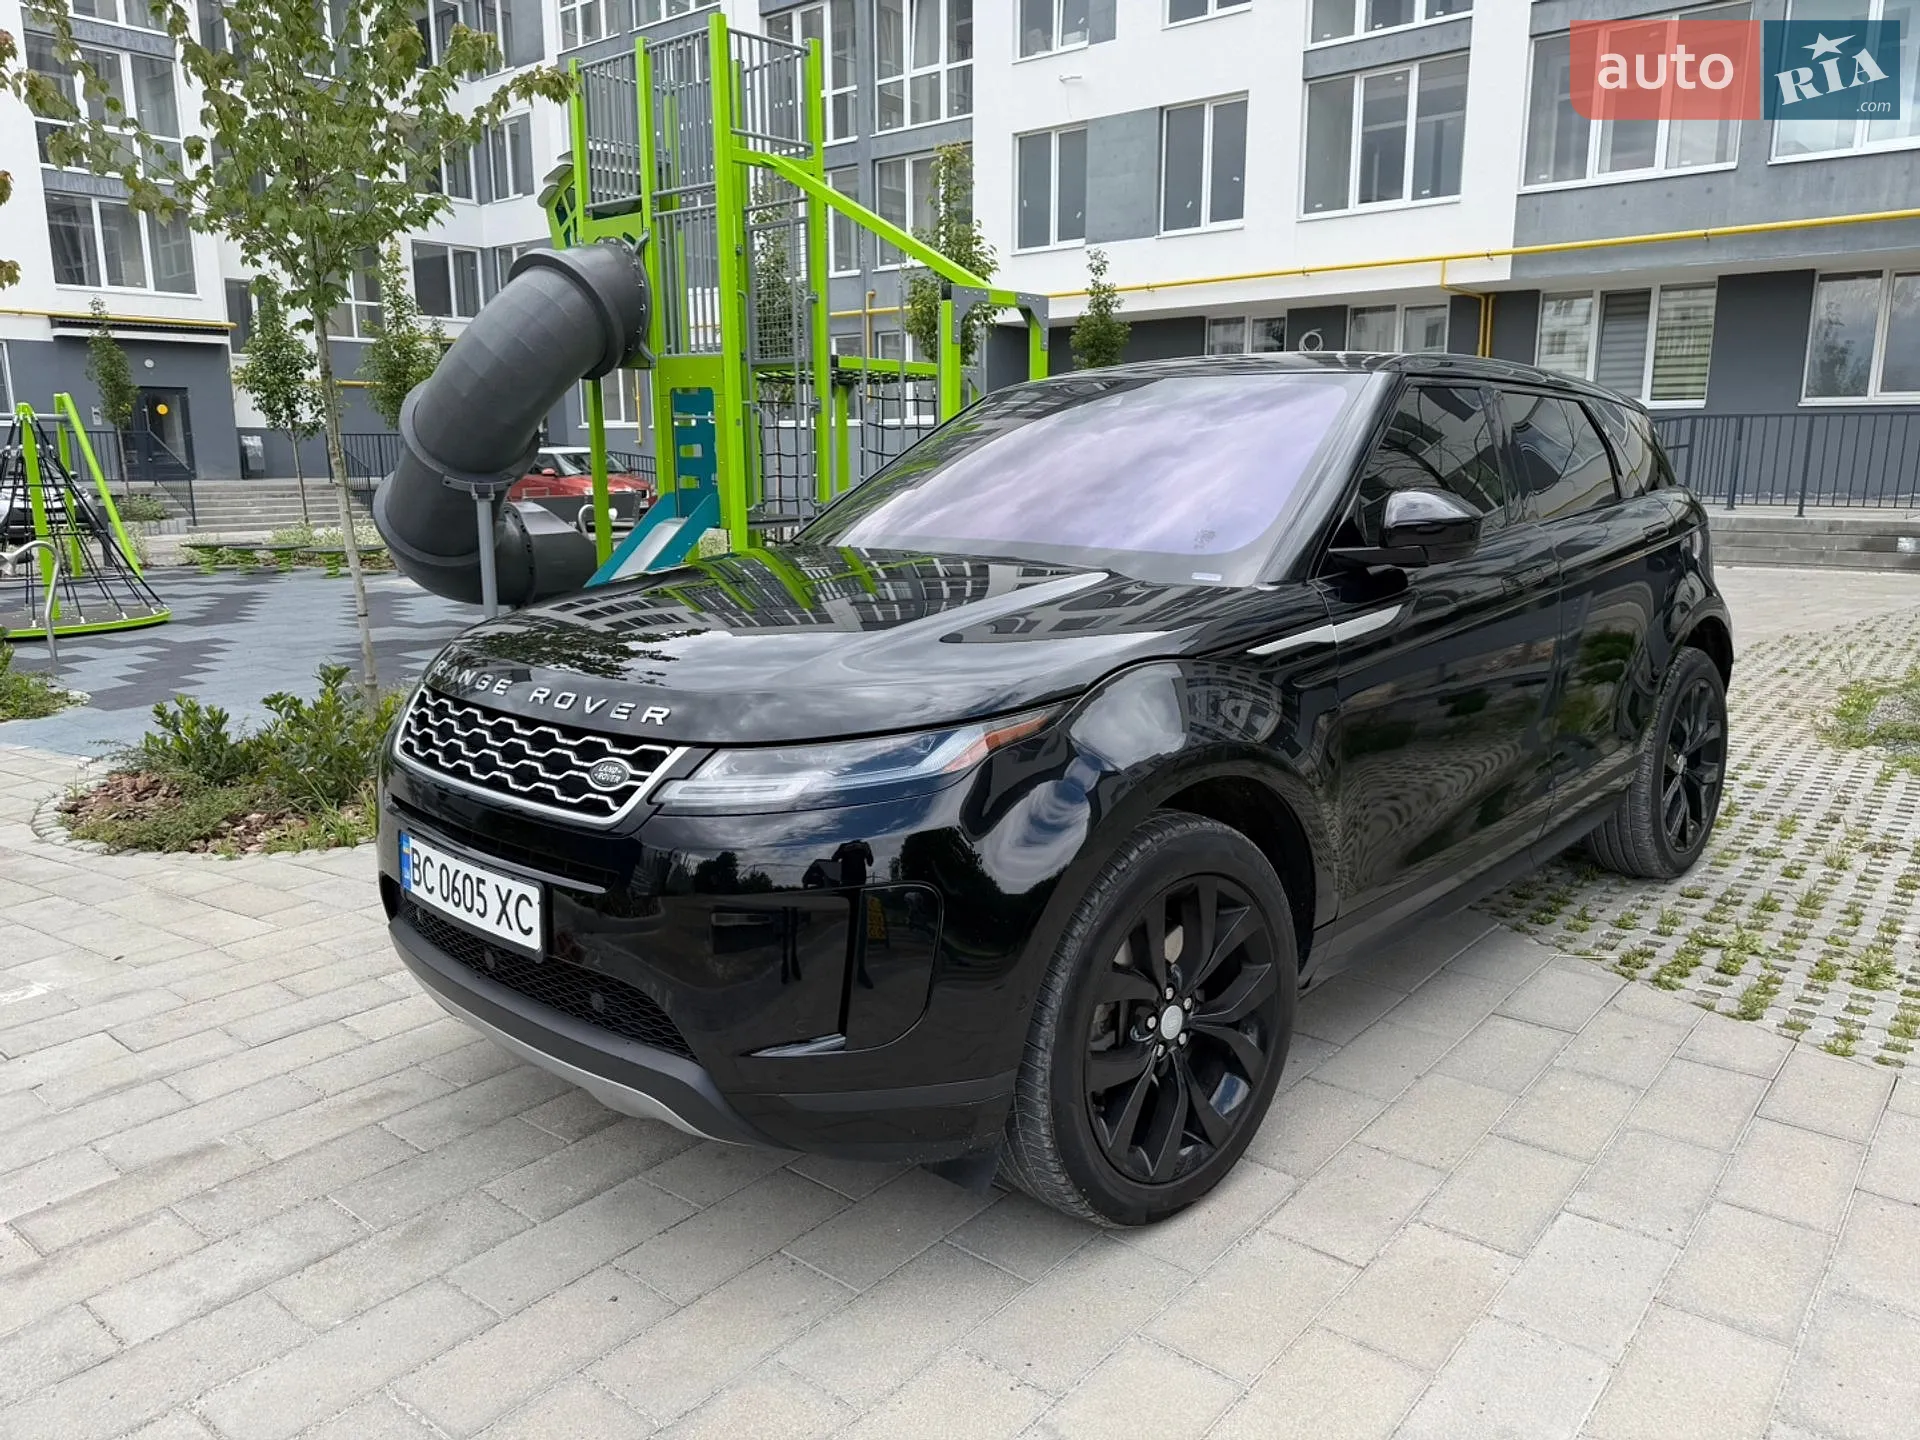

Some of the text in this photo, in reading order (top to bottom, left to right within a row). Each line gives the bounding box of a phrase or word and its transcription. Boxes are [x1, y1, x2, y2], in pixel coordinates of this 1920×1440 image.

[433, 659, 671, 726] RANGE ROVER
[597, 772, 621, 784] ROVER
[598, 763, 619, 774] LAND
[411, 847, 534, 936] BC 0605 XC
